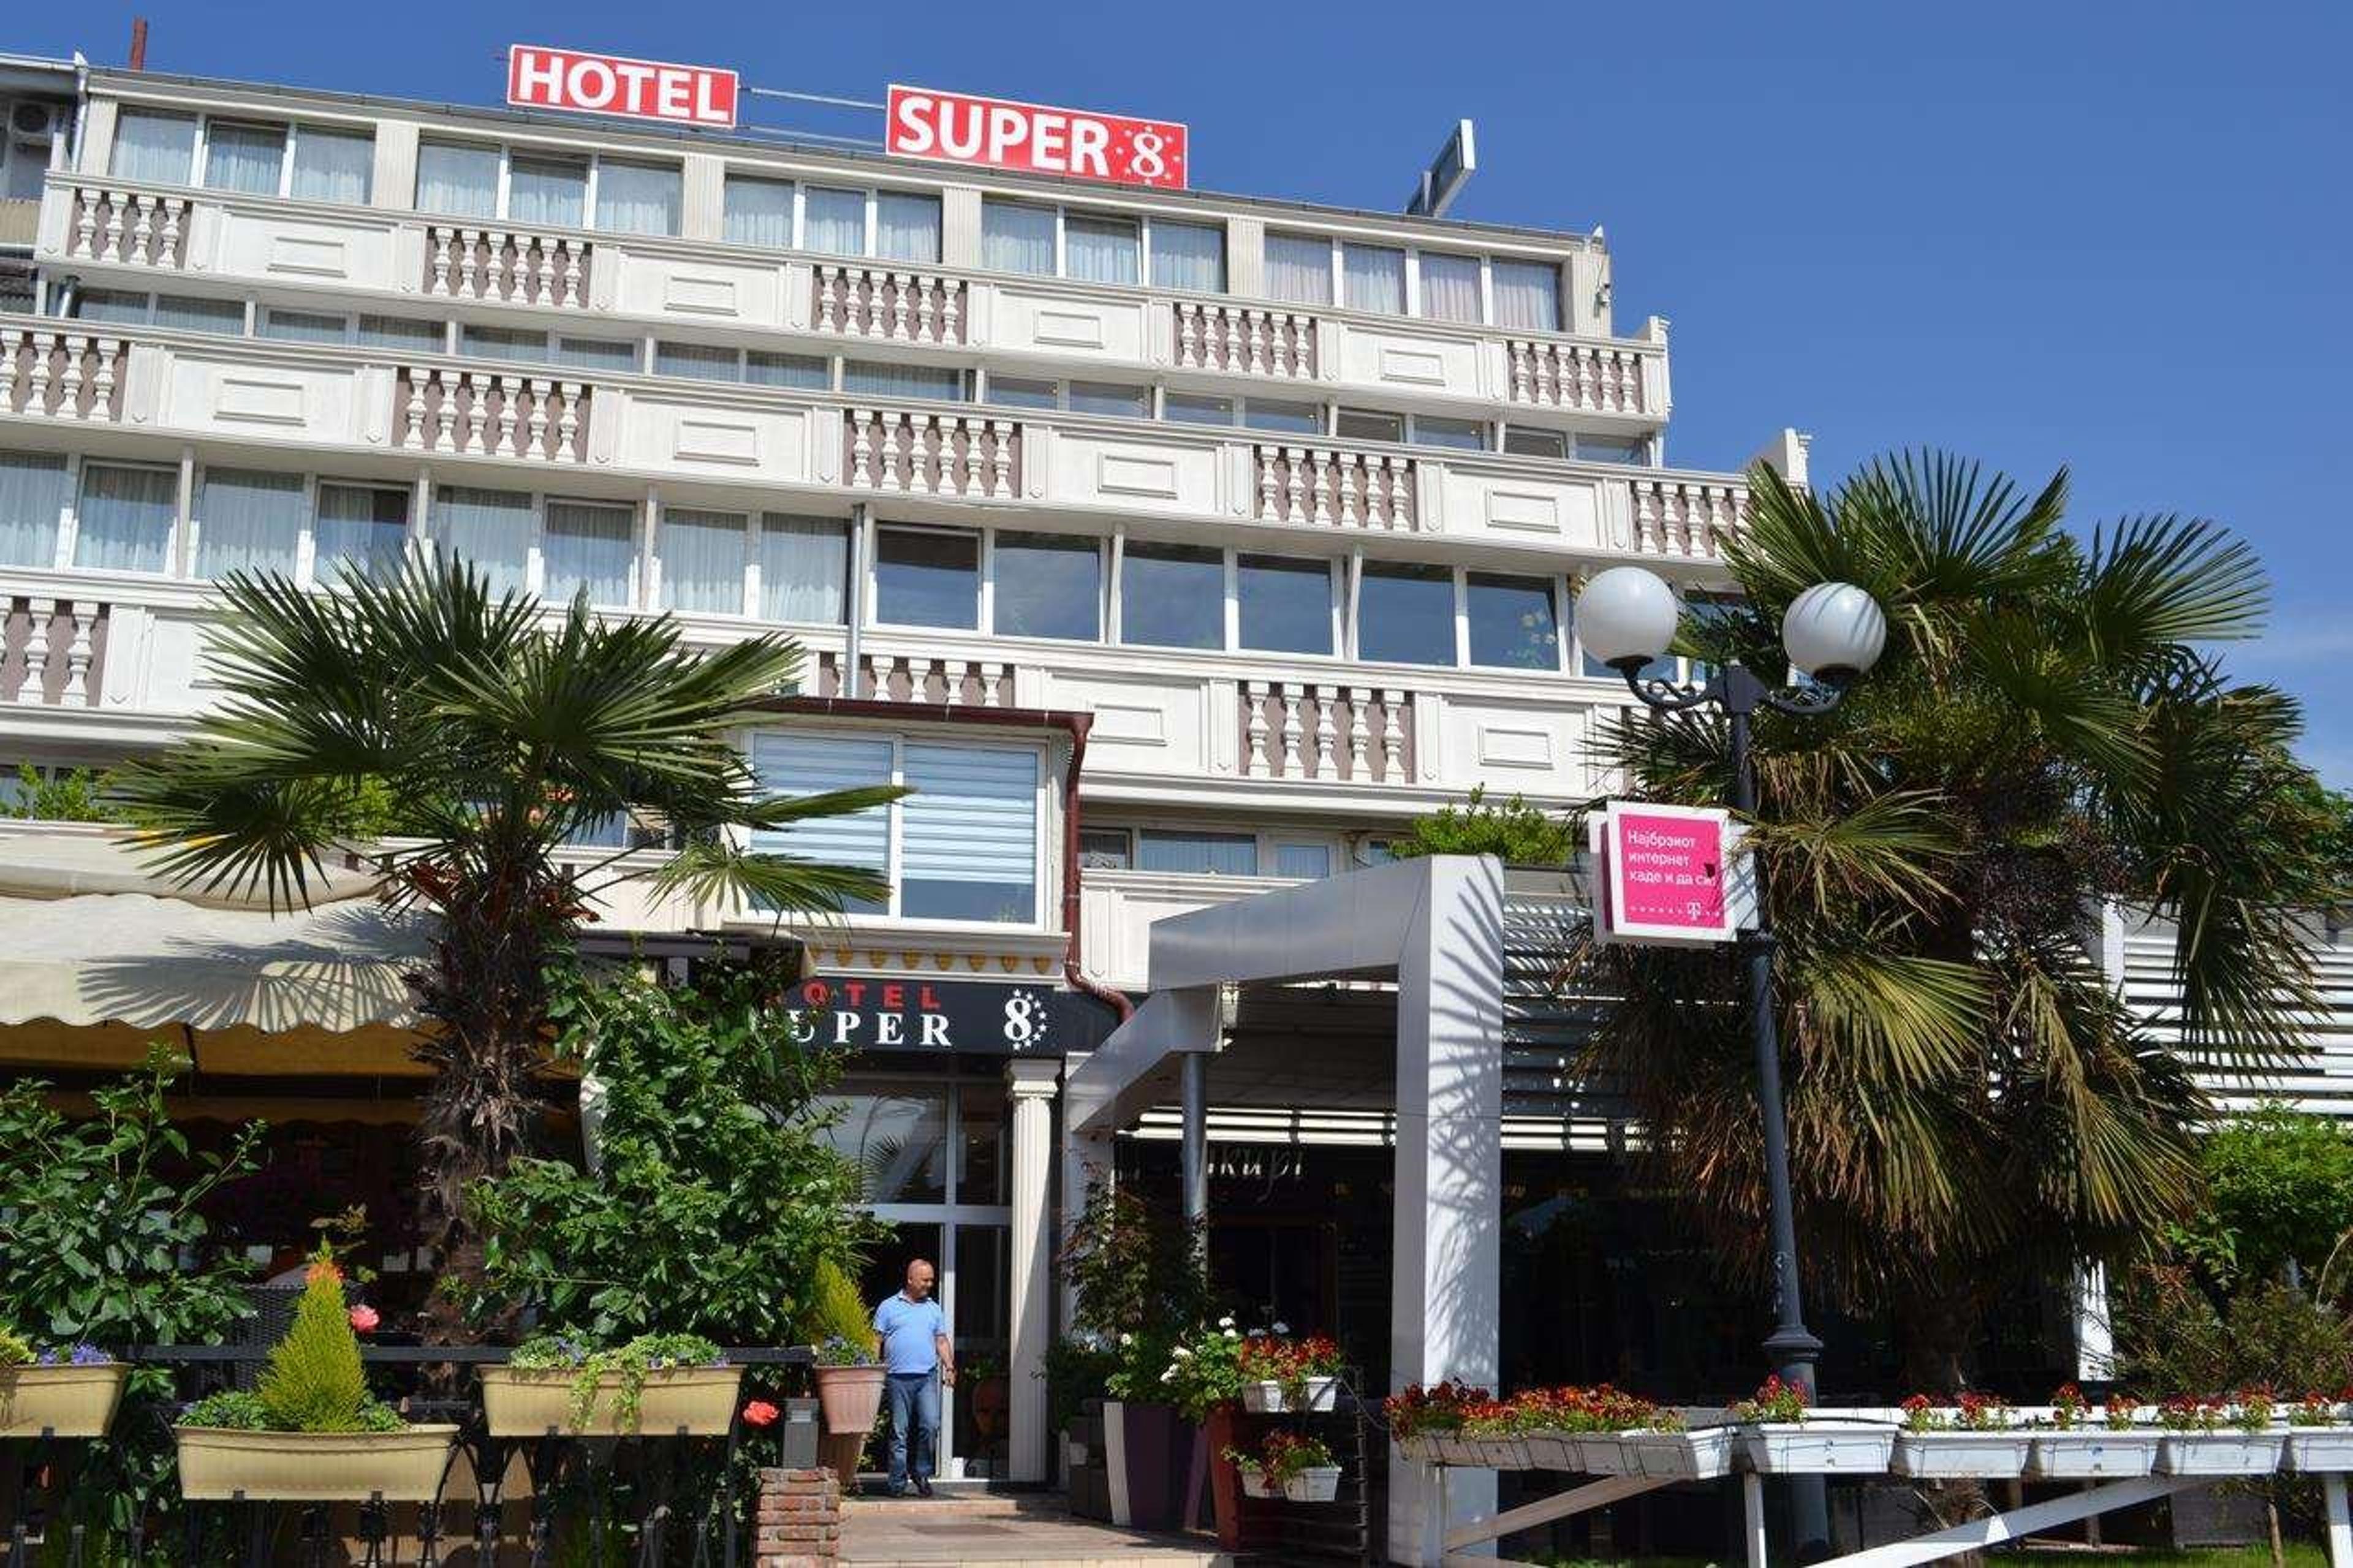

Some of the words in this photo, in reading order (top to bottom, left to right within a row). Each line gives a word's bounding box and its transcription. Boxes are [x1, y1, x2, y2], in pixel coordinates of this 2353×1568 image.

[518, 51, 729, 121] HOTEL
[896, 97, 1109, 176] SUPER
[1129, 132, 1164, 178] 8
[1627, 830, 1696, 849] Најбрзиот
[1628, 854, 1690, 868] интернет
[1629, 872, 1662, 885] каде
[1676, 876, 1694, 885] да
[1004, 997, 1033, 1042] 8
